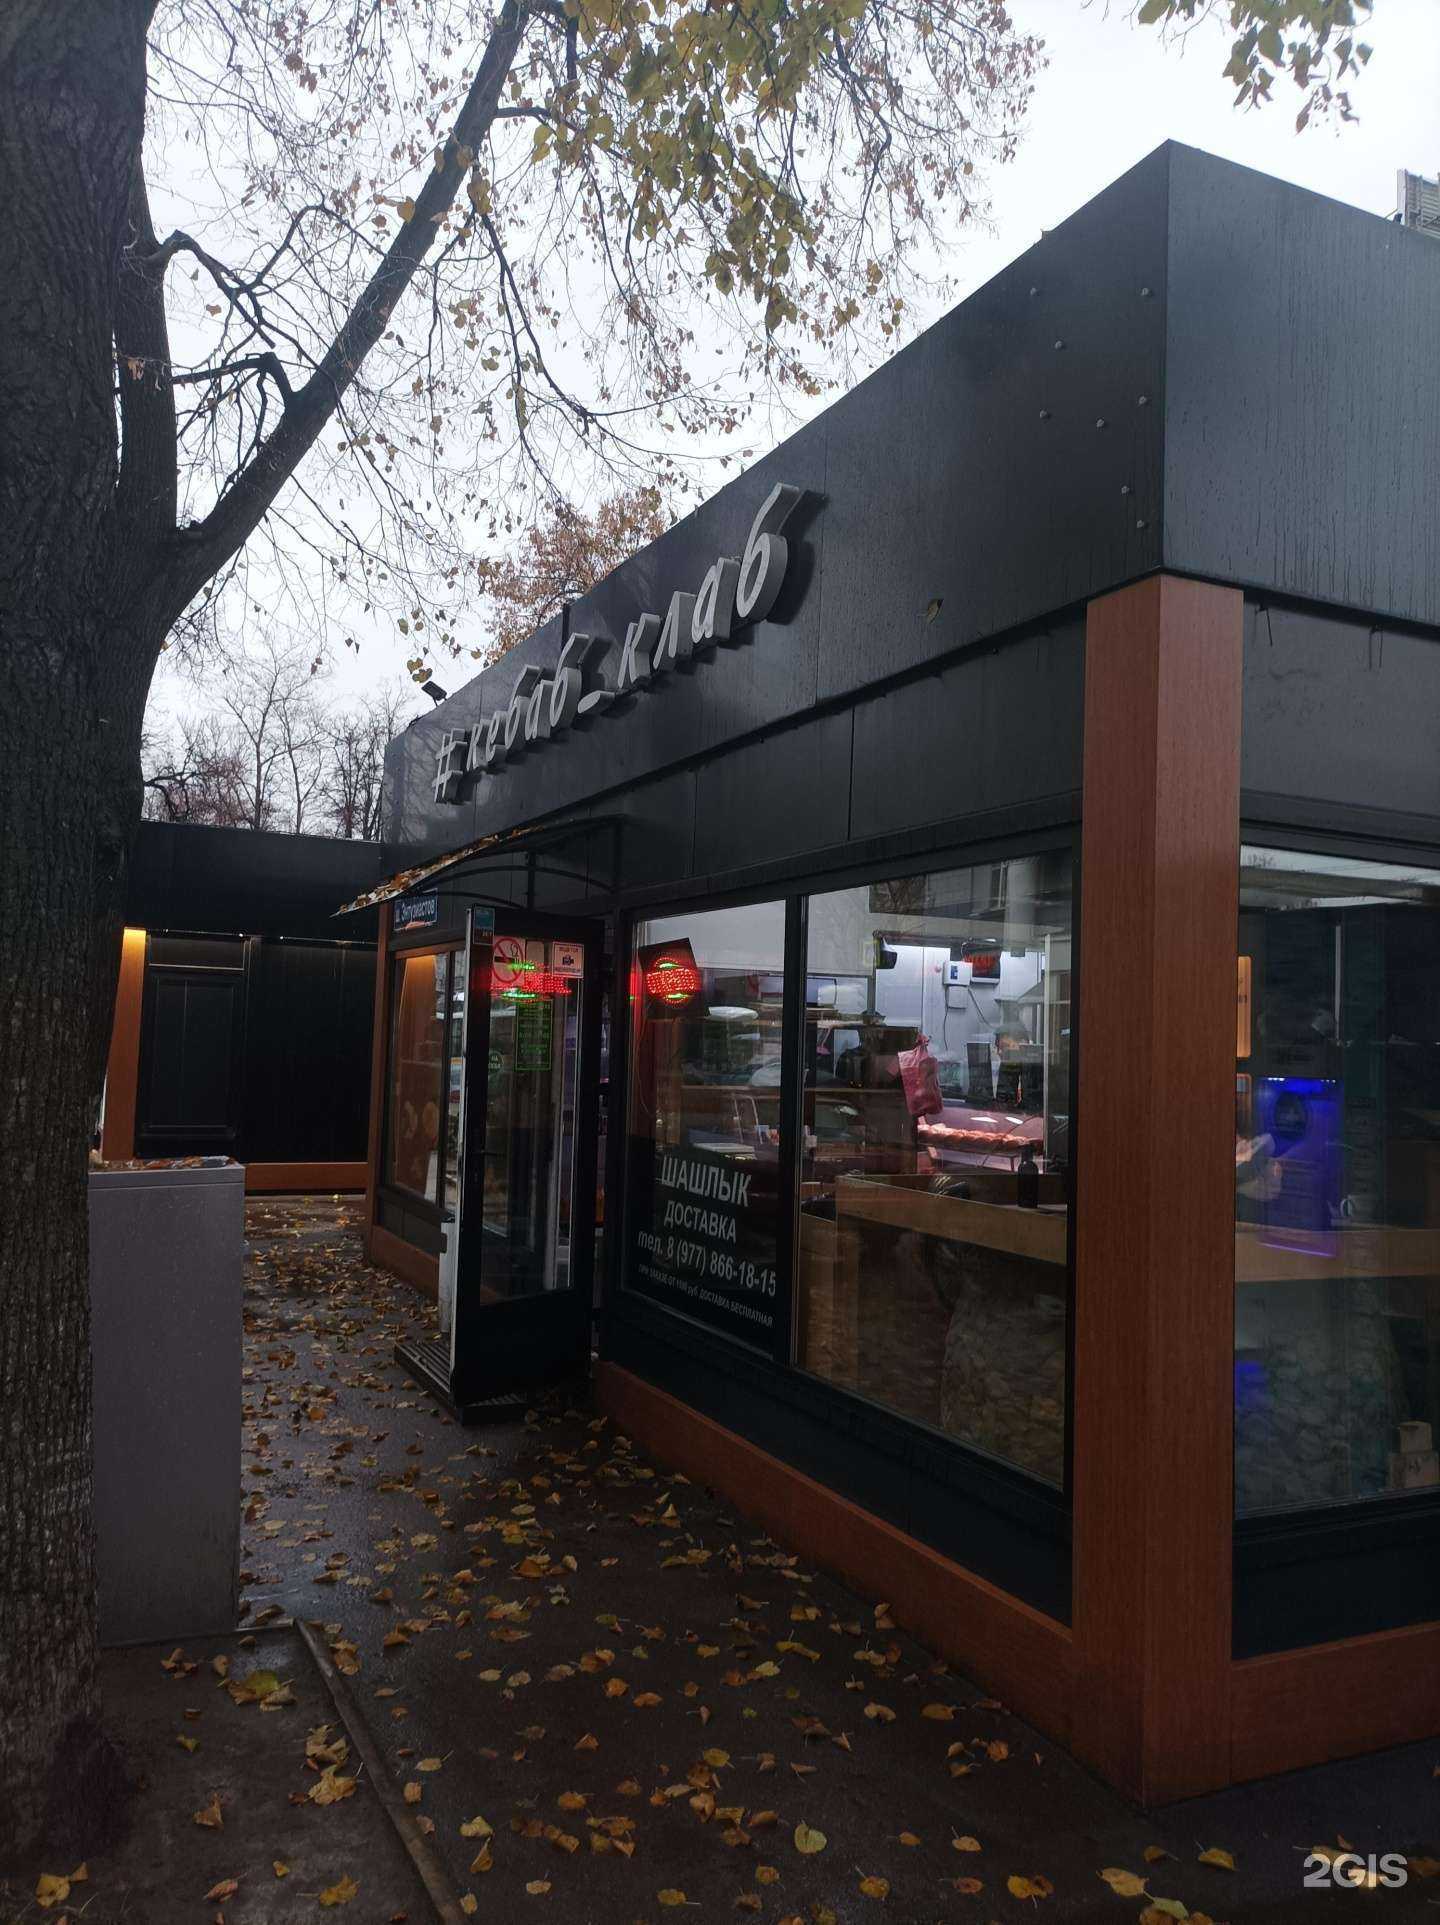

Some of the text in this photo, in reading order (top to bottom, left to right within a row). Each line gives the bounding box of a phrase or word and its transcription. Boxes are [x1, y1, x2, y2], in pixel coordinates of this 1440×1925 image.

[662, 1155, 752, 1207] ШАШЛЫК
[664, 1200, 736, 1243] ДОСТАВКА
[638, 1231, 777, 1297] тел. 8 (977) 866-18-15
